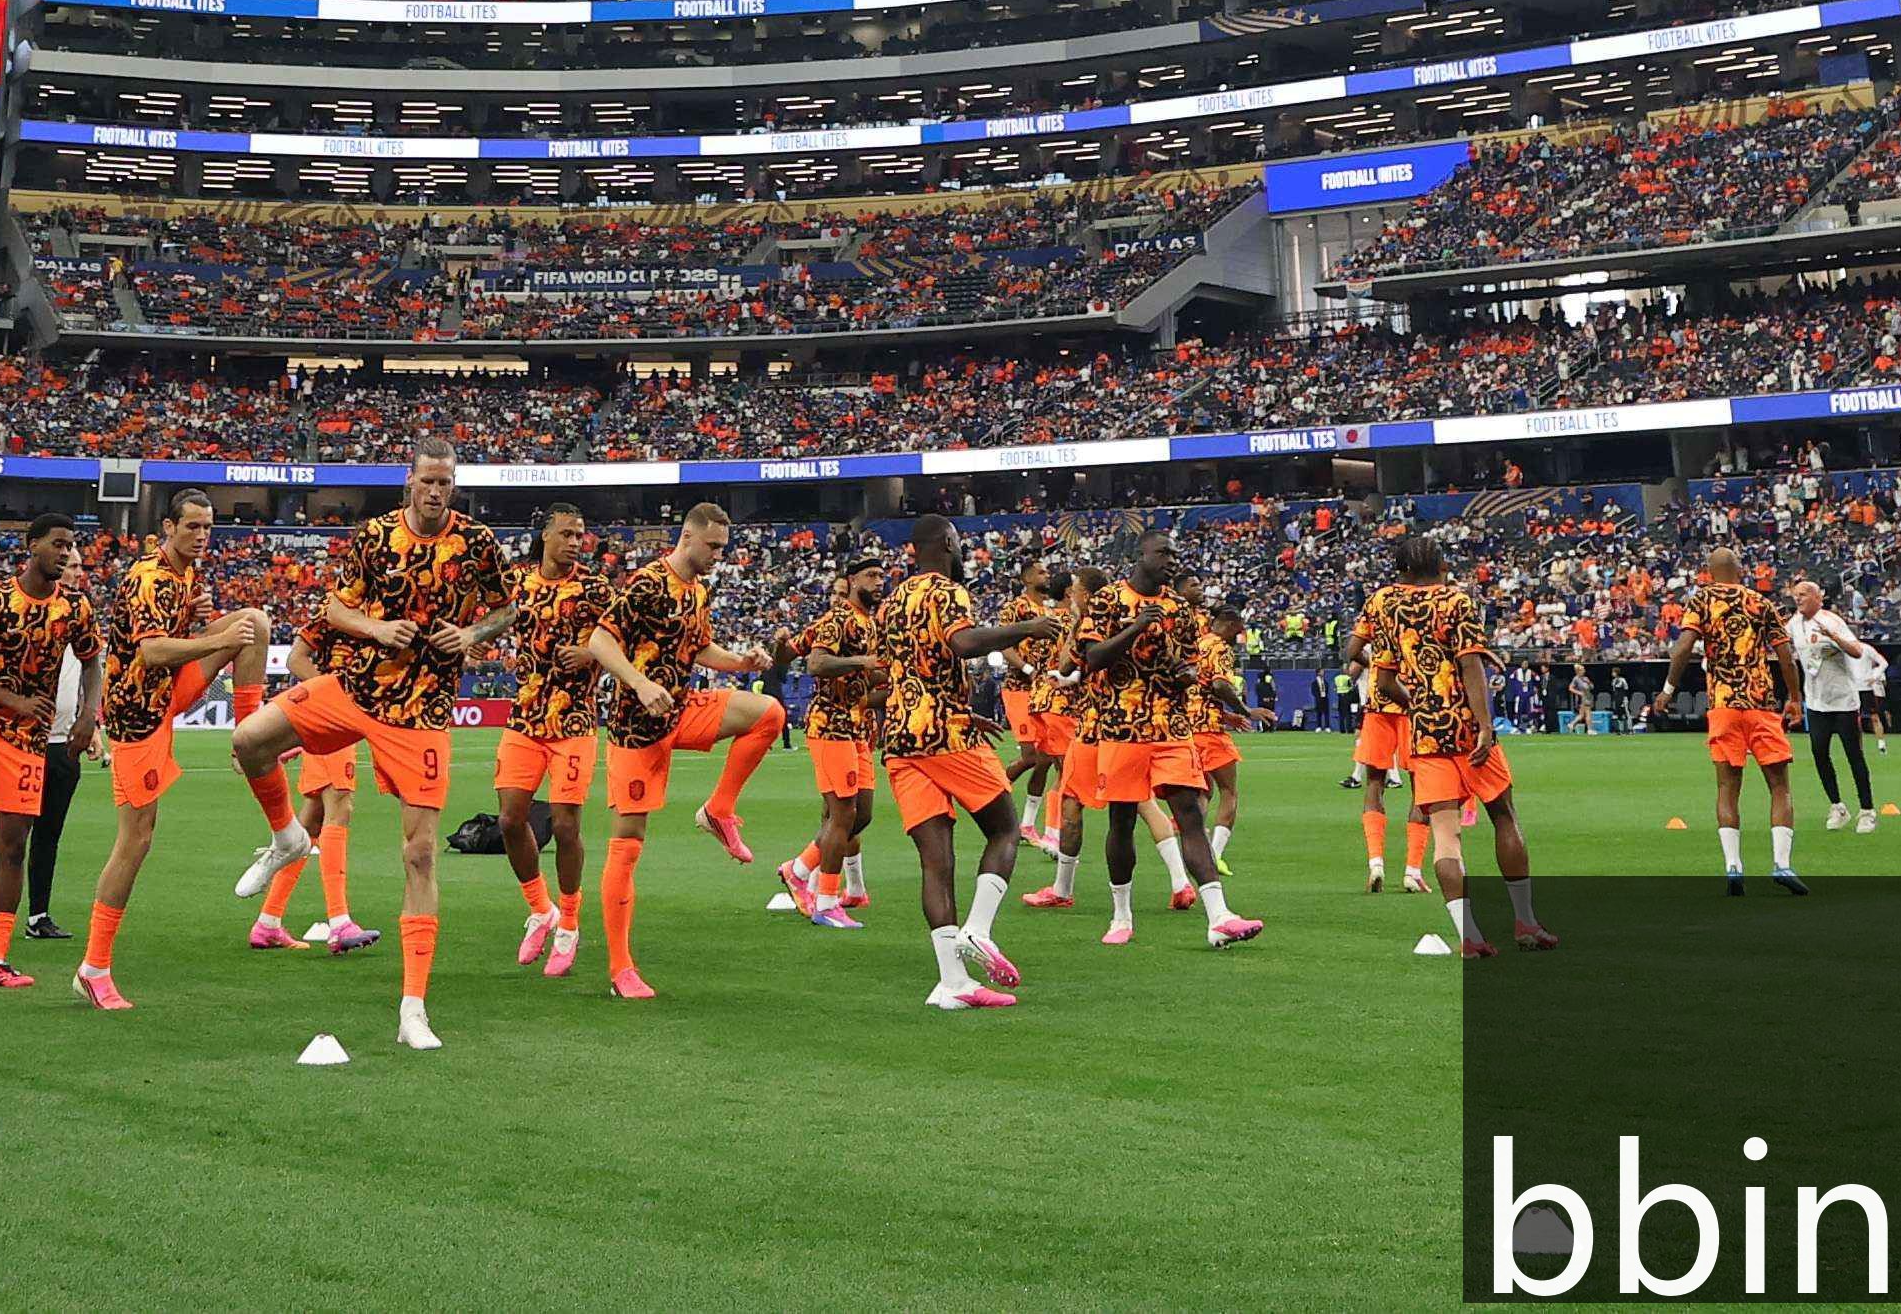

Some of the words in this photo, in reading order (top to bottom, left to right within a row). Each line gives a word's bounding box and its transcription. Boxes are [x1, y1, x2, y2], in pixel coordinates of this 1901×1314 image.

[405, 3, 464, 19] FOOTBALL
[1648, 27, 1703, 50] FOOTBALL
[1414, 61, 1463, 85] FOOTBALL
[1197, 92, 1244, 113] FOOTBALL
[94, 125, 145, 146] FOOTBALL
[986, 117, 1034, 138] FOOTBALL
[323, 139, 373, 154] FOOTBALL
[549, 140, 597, 157] FOOTBALL
[770, 133, 819, 149] FOOTBALL
[1321, 168, 1378, 190] FOOTBALL
[34, 259, 102, 272] DALLAS
[534, 271, 567, 284] FIFA
[570, 270, 627, 284] WORLD
[1525, 413, 1591, 435] FOOTBALL
[1249, 431, 1309, 452] FOOTBALL
[999, 449, 1053, 467] FOOTBALL
[226, 466, 288, 483] FOOTBALL
[499, 467, 557, 482] FOOTBALL
[761, 461, 815, 479] FOOTBALL
[423, 747, 439, 780] 9
[566, 755, 580, 783] 5
[17, 763, 42, 793] 25
